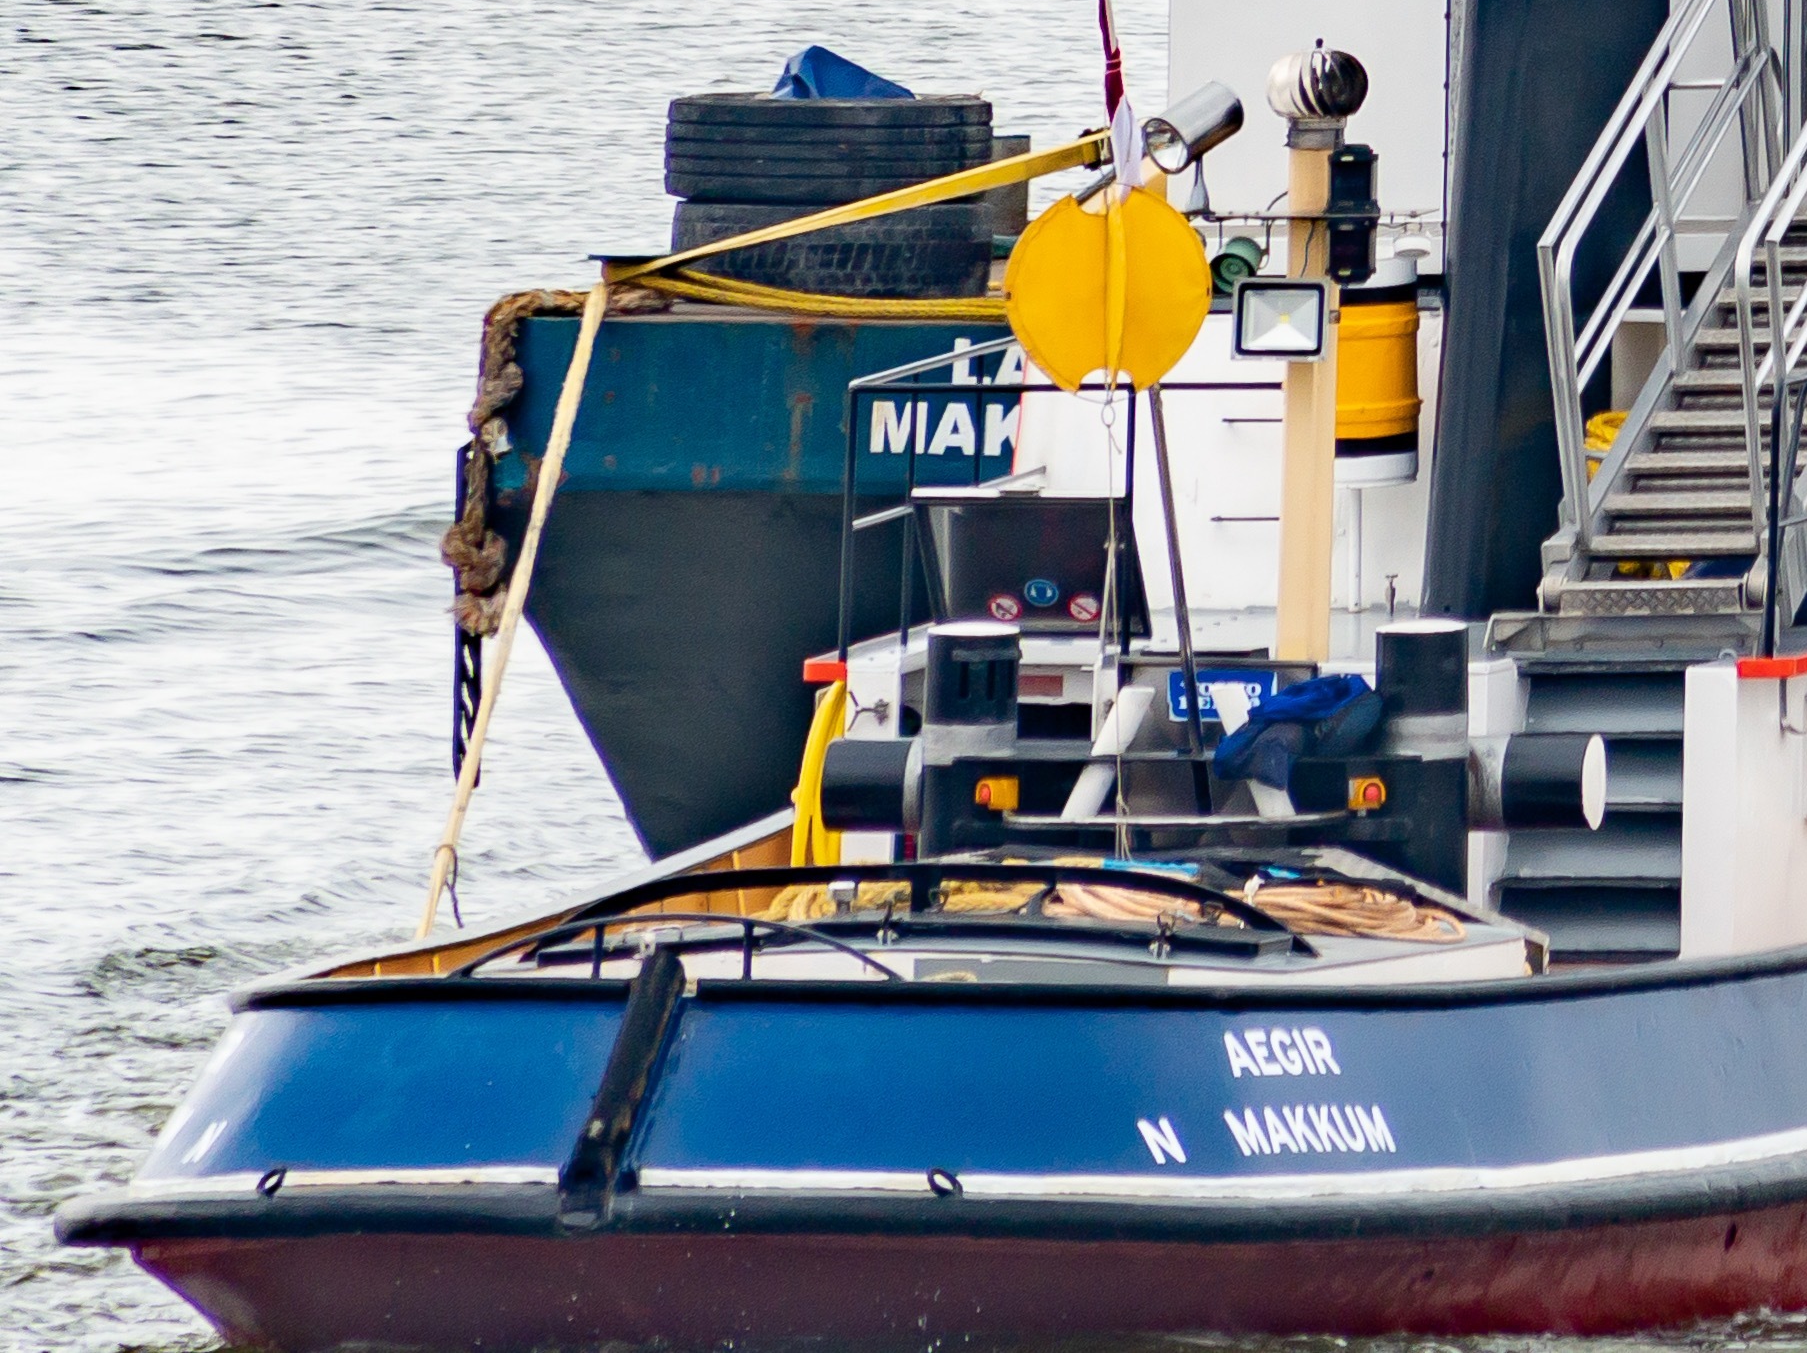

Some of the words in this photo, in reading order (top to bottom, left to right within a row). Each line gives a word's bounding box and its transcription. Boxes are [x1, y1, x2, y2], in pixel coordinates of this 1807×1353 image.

[1223, 1027, 1341, 1079] AEGIR
[1137, 1116, 1187, 1165] N
[1223, 1104, 1397, 1157] MAKKUM
